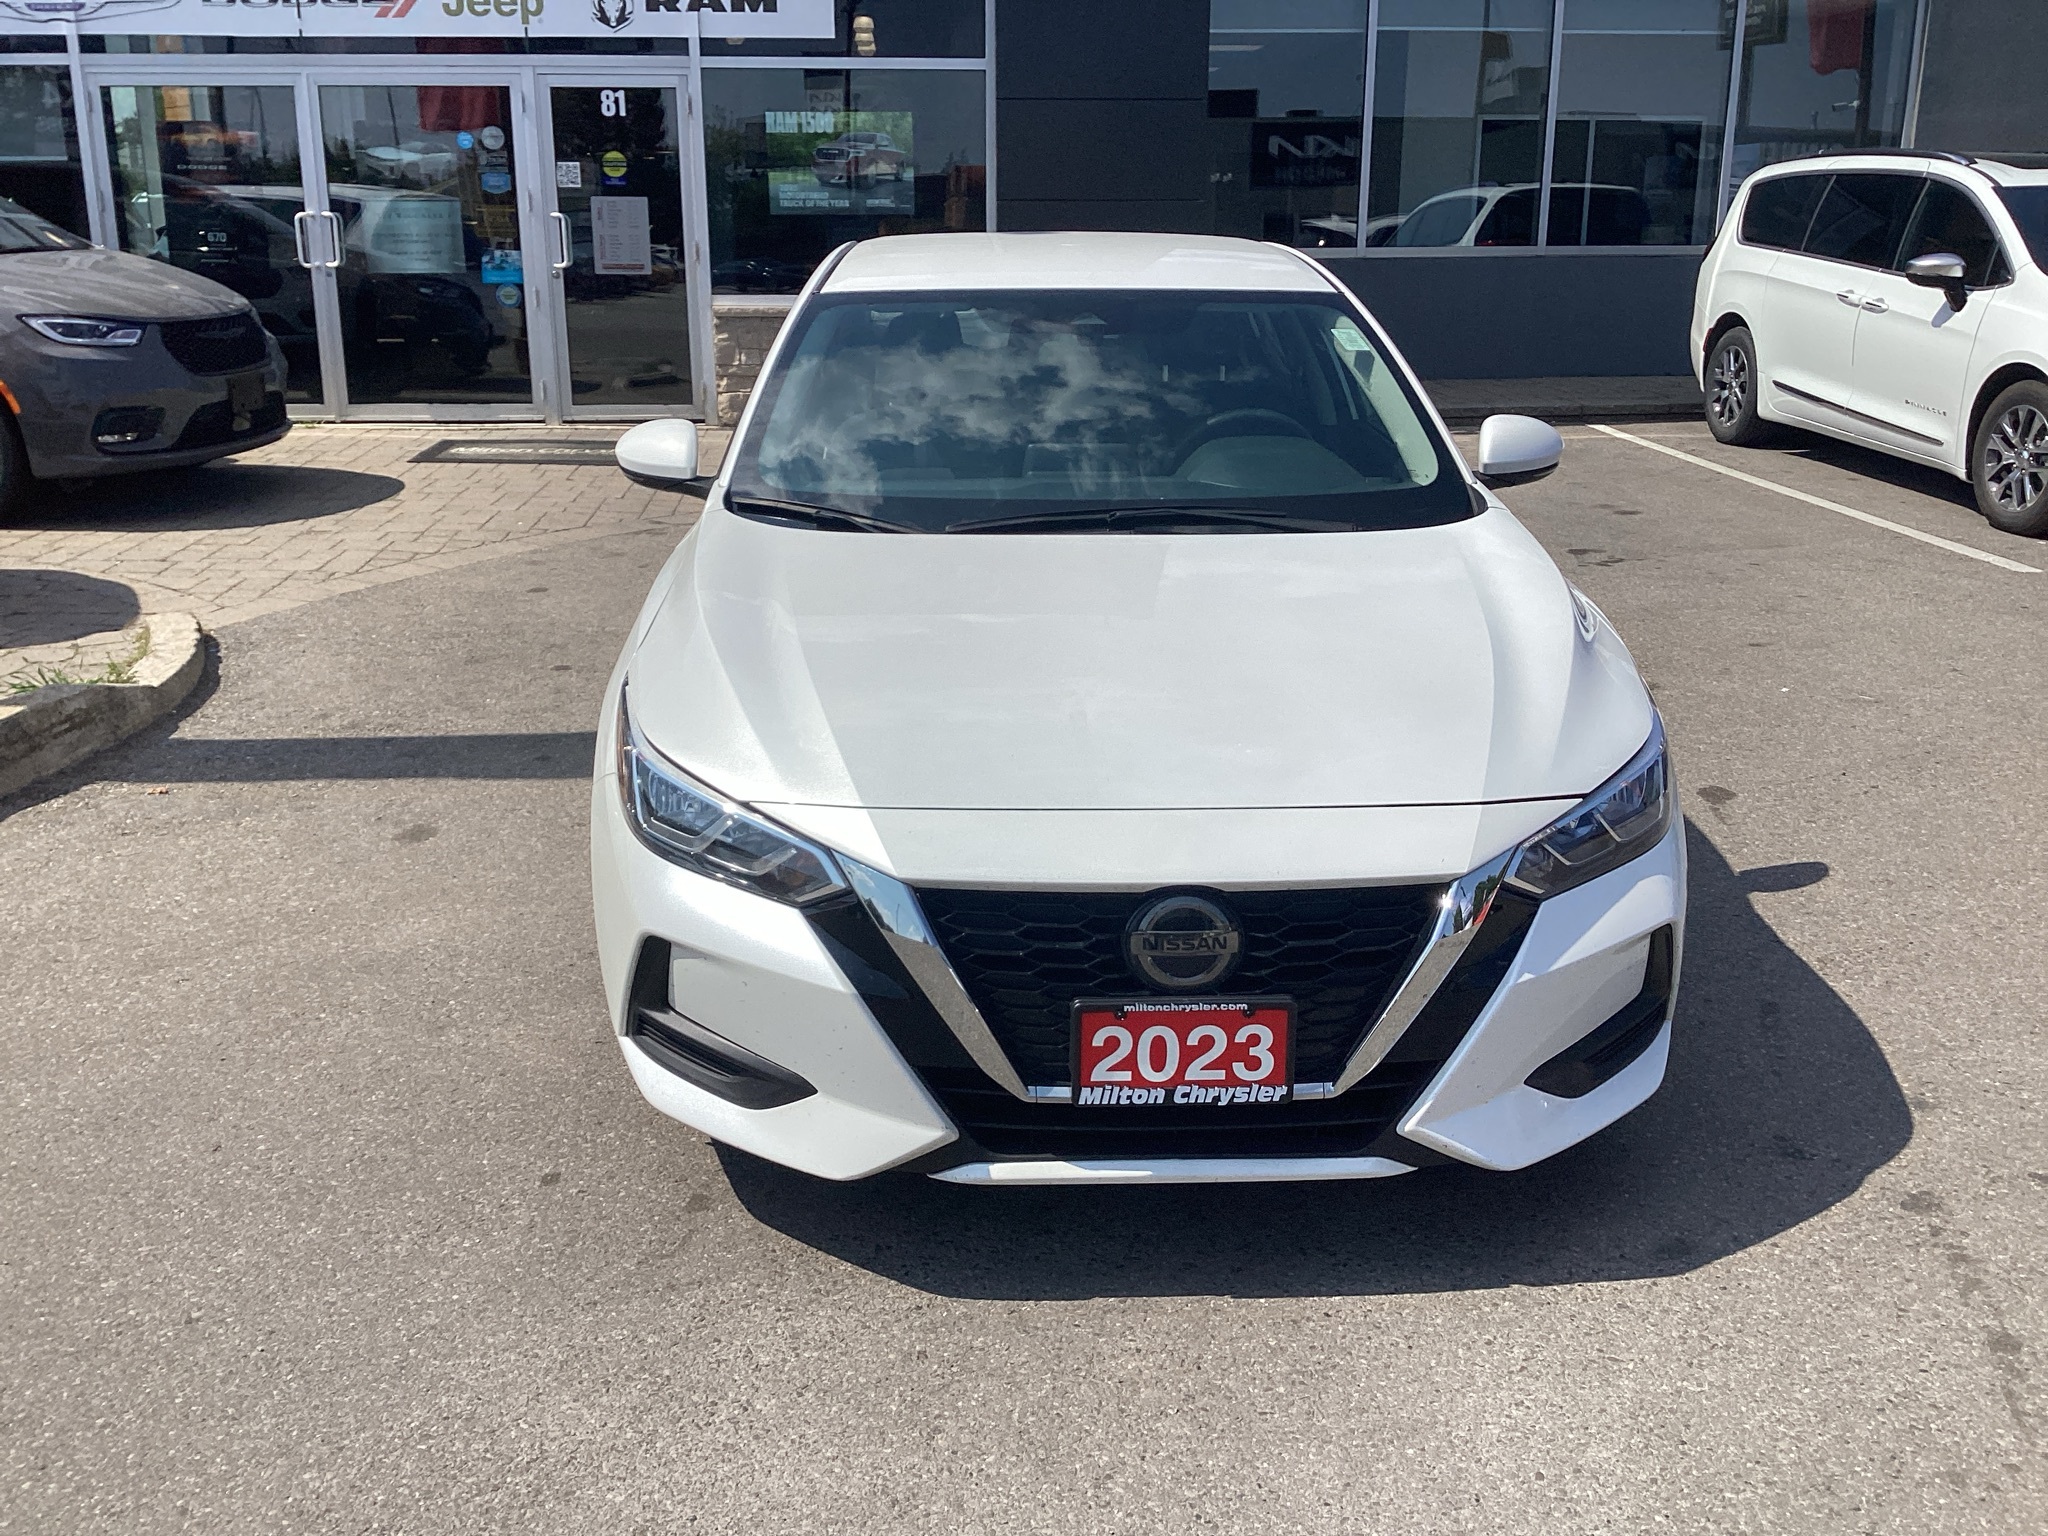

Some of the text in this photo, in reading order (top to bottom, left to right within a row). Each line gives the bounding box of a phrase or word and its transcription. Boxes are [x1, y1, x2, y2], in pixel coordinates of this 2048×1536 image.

[442, 0, 544, 24] Jeep
[600, 90, 626, 117] 81
[765, 111, 833, 133] RAM 1500
[1143, 936, 1227, 951] NISSAN
[1124, 1002, 1248, 1012] miltonchrysler.com
[1091, 1024, 1275, 1082] 2023
[1078, 1084, 1288, 1106] Milton Chrysler
